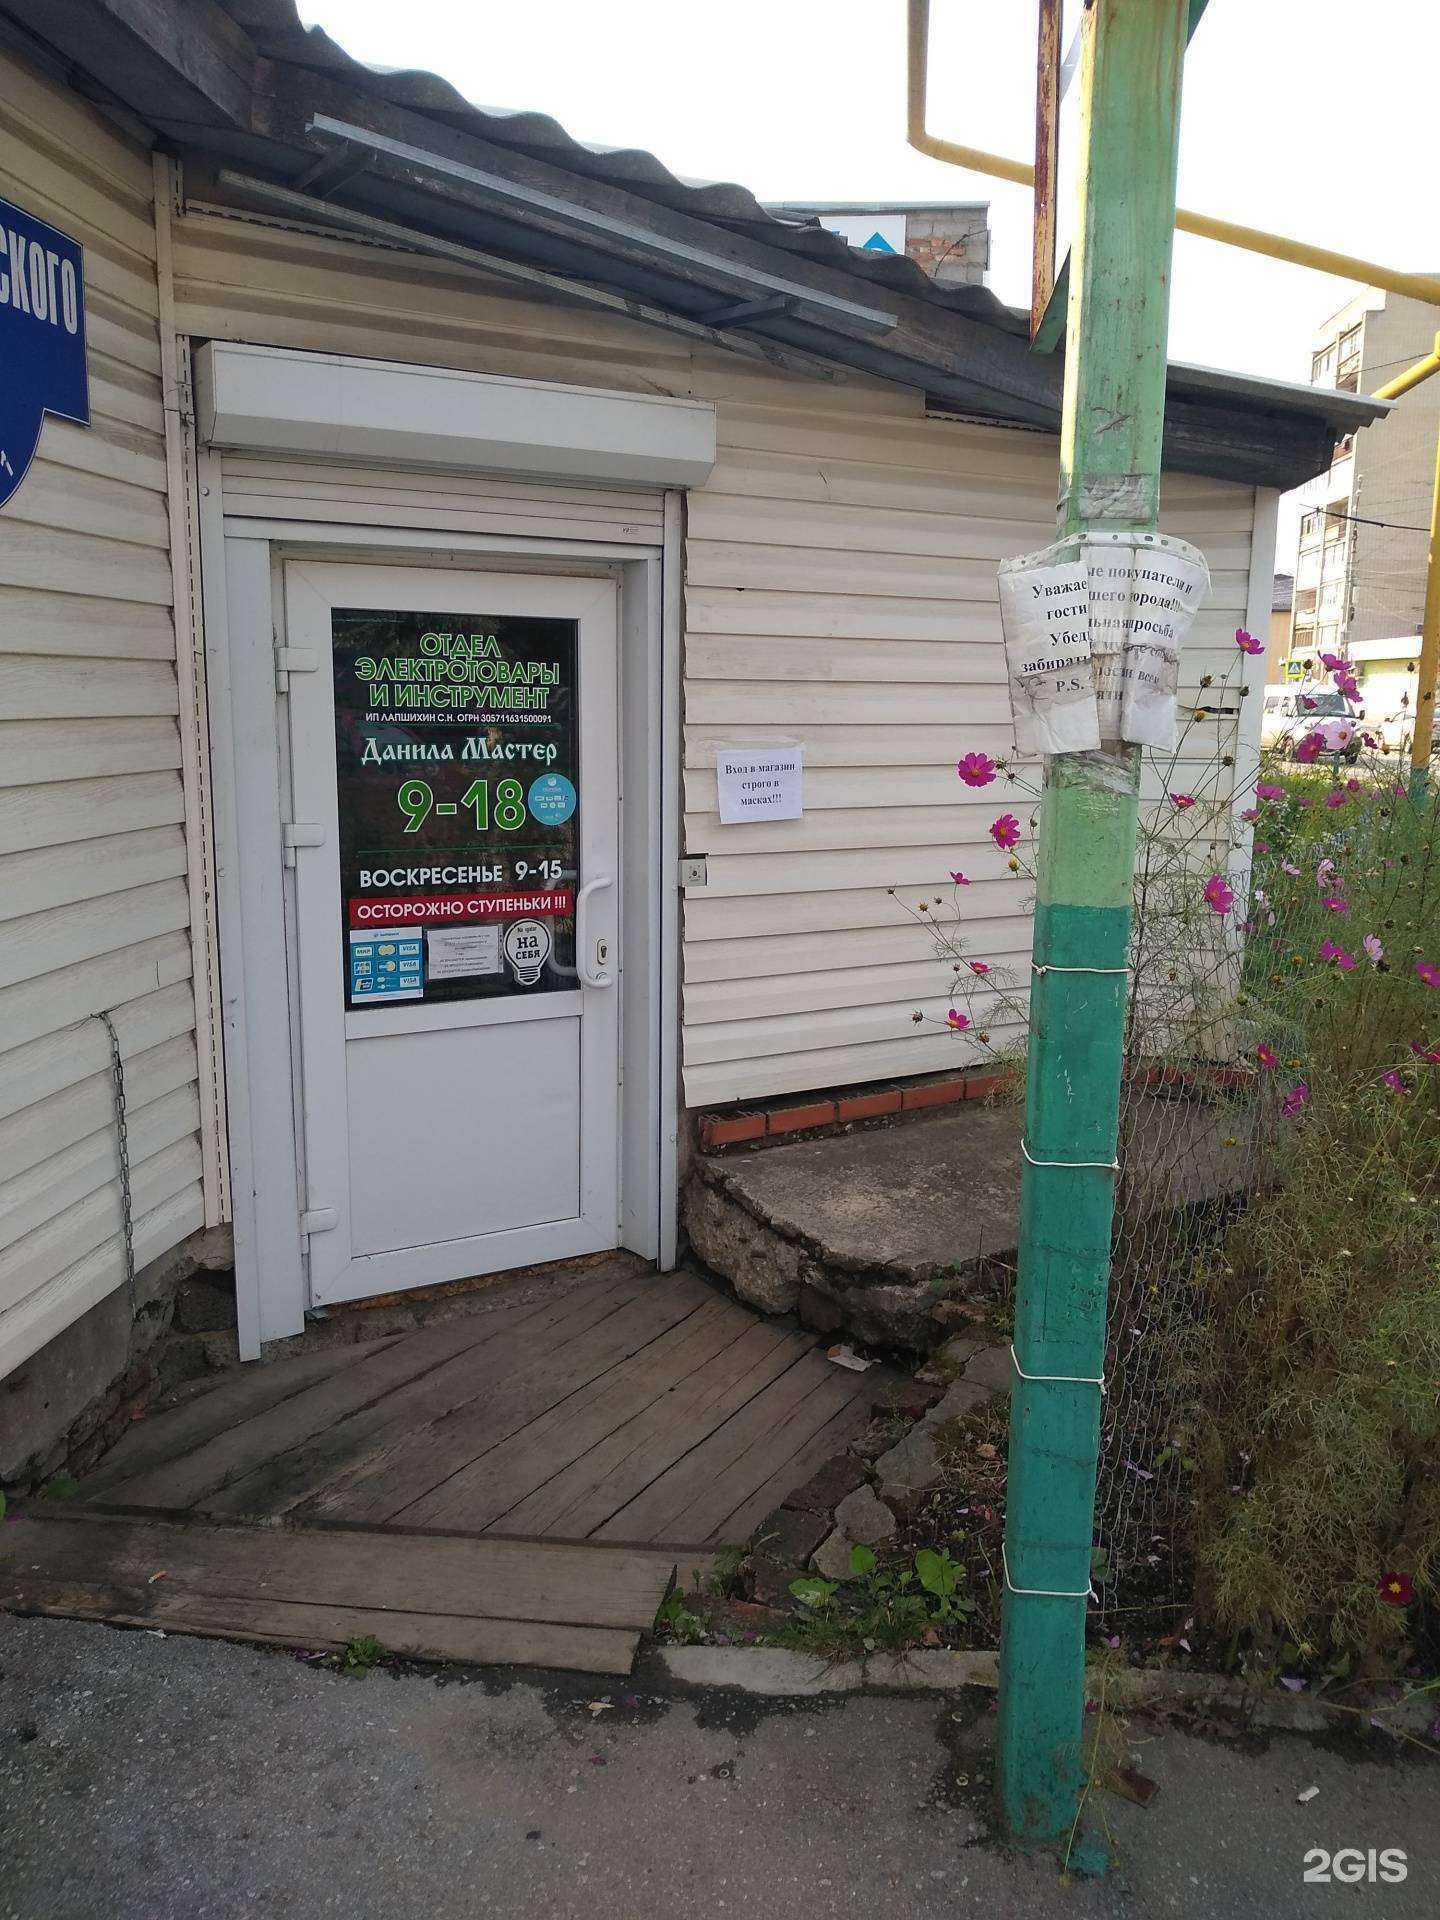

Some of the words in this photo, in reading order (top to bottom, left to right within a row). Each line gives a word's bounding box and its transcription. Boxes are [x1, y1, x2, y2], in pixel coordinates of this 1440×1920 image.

[1047, 604, 1087, 620] гости
[420, 632, 502, 661] ОТДЕЛ
[354, 656, 560, 685] ЭЛЕКТРОТОВАРЫ
[1056, 678, 1085, 693] P.S.
[369, 683, 389, 707] И
[395, 683, 550, 709] ИНСТРУМЕНТ
[365, 713, 380, 721] ИП
[381, 713, 436, 722] ЛАПШИХИН
[437, 713, 456, 722] С.Н.
[457, 713, 480, 722] ОГРН
[361, 737, 454, 766] Данила
[461, 737, 557, 766] Мастер
[725, 764, 748, 775] Вход
[750, 765, 756, 773] в
[758, 763, 795, 773] магазин
[742, 780, 772, 791] строго
[774, 780, 780, 788] в
[397, 778, 526, 833] 9-18
[360, 865, 503, 888] ВОСКРЕСЕНЬЕ
[515, 859, 563, 880] 9-15
[357, 901, 464, 919] ОСТОРОЖНО
[466, 896, 551, 914] СТУПЕНЬКИ
[517, 936, 539, 949] на
[515, 950, 541, 960] СЕБЯ
